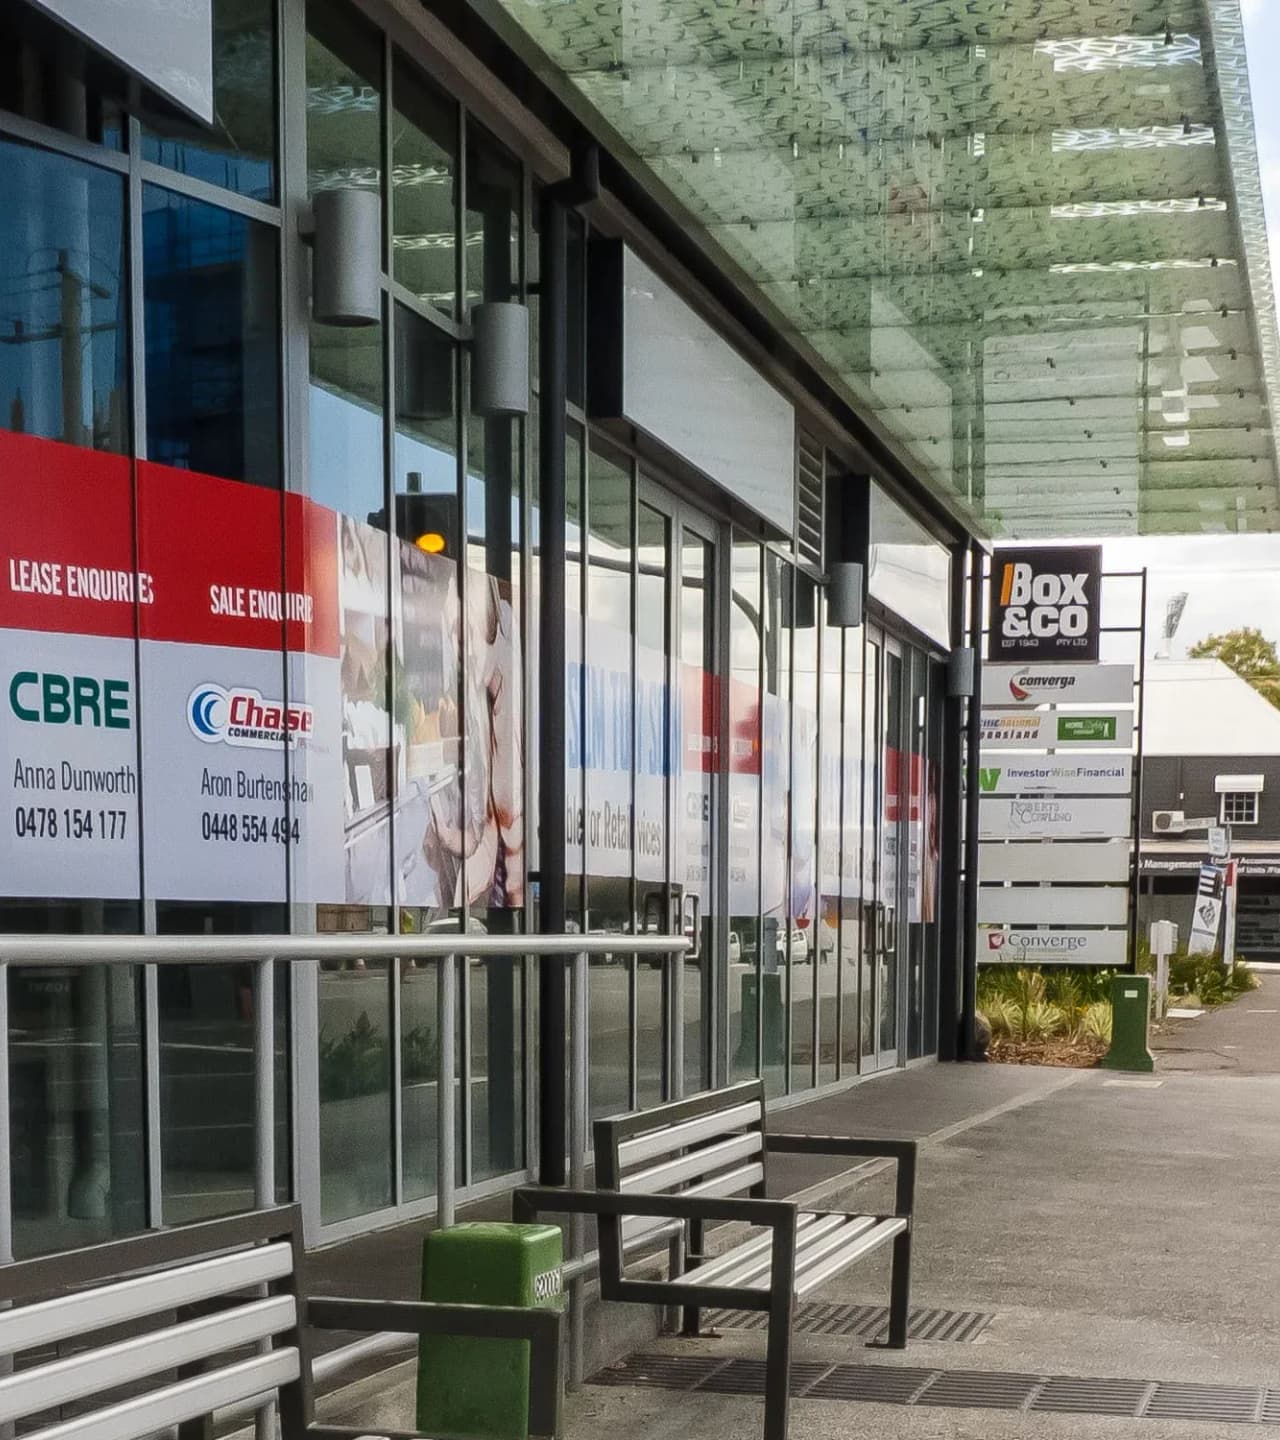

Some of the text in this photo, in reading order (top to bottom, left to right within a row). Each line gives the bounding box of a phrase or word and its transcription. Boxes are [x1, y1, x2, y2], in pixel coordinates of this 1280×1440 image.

[9, 559, 154, 604] LEASE ENQUIRIES
[210, 585, 246, 617] SALE
[1019, 676, 1076, 689] converga
[9, 671, 132, 730] CBRE
[229, 696, 312, 732] Chase
[228, 727, 295, 743] COMMERCIAL
[13, 758, 137, 795] Anna Dunworth
[201, 767, 232, 797] Aron
[15, 806, 127, 840] 0478 154 177
[201, 811, 238, 842] 0448
[242, 814, 268, 843] 554
[1144, 859, 1203, 872] Management
[1007, 933, 1088, 950] Converge
